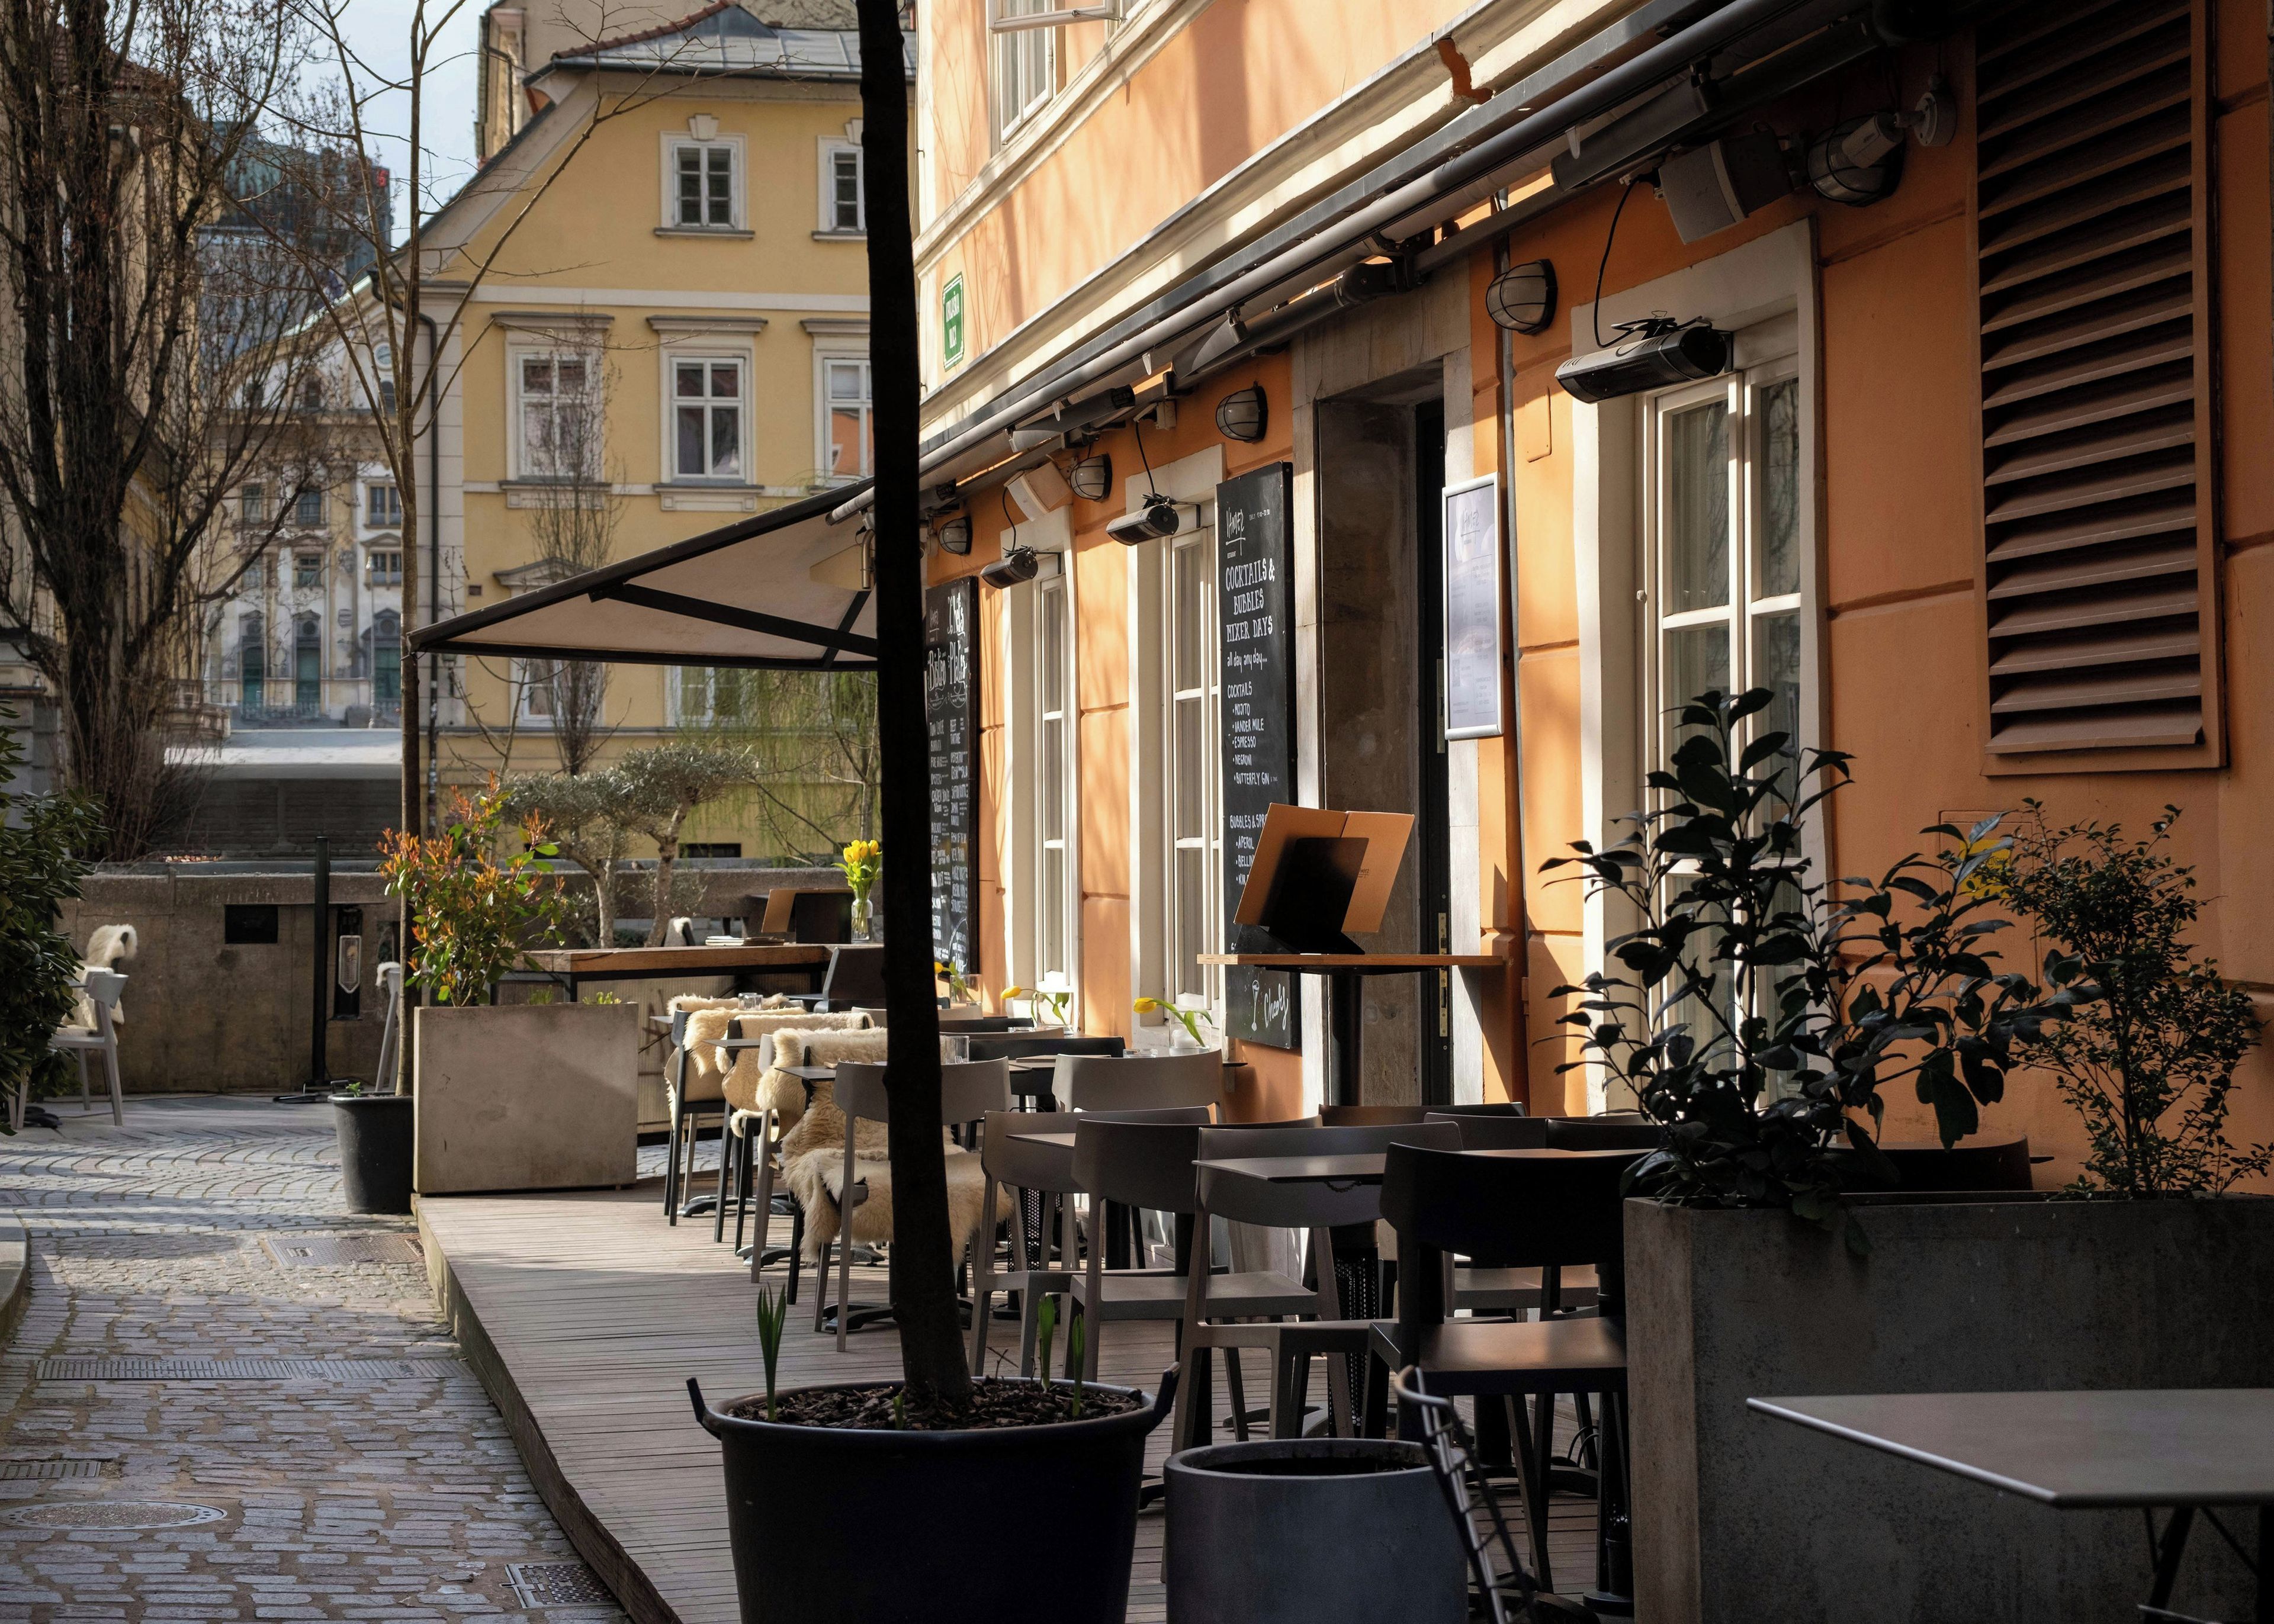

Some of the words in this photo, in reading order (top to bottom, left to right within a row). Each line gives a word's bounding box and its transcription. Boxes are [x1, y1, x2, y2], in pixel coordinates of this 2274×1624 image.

[1226, 558, 1267, 591] COCKTAILS
[1268, 558, 1275, 582] &
[1234, 588, 1264, 615] BUBBLES
[1226, 620, 1250, 642] MIXER
[1252, 615, 1273, 638] DAYS
[1234, 651, 1242, 673] day
[1244, 654, 1252, 671] any
[1227, 681, 1252, 699] COCKTAILS
[1234, 703, 1251, 716] MOJITO
[1252, 718, 1264, 731] MULE
[1234, 735, 1256, 749] ESPRESSO
[1235, 754, 1252, 766] NEGRONI
[1235, 772, 1260, 786] BUTTERFLY
[1261, 772, 1270, 785] GIN
[1229, 815, 1251, 829] BUBBLES
[1251, 815, 1255, 829] &
[1238, 835, 1254, 850] APEROL
